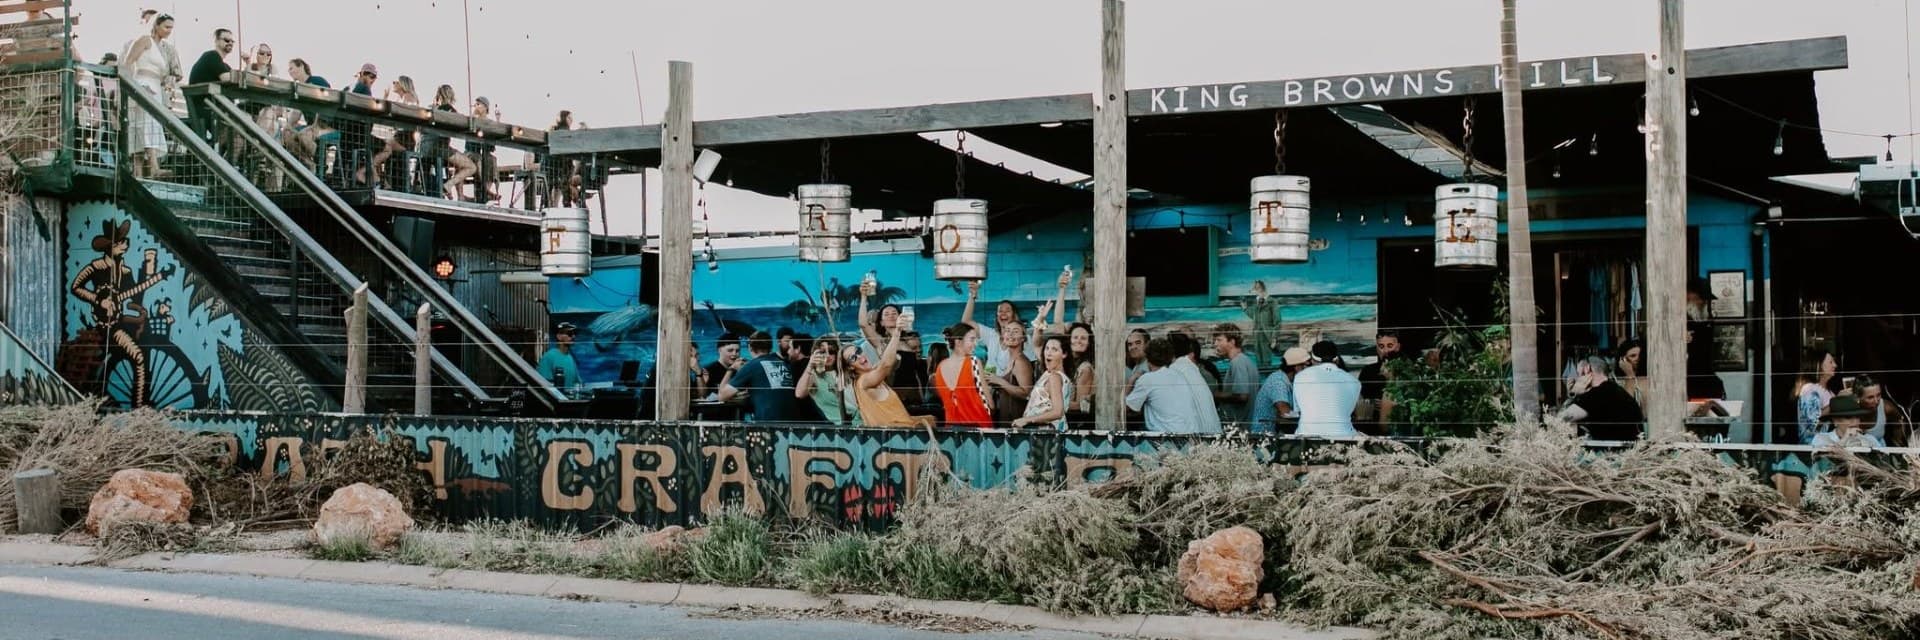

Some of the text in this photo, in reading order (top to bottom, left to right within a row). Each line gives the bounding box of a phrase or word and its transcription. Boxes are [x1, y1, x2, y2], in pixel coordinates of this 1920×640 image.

[1151, 85, 1249, 113] KING
[1284, 69, 1454, 105] BROWNS
[541, 440, 951, 519] CRAFT
